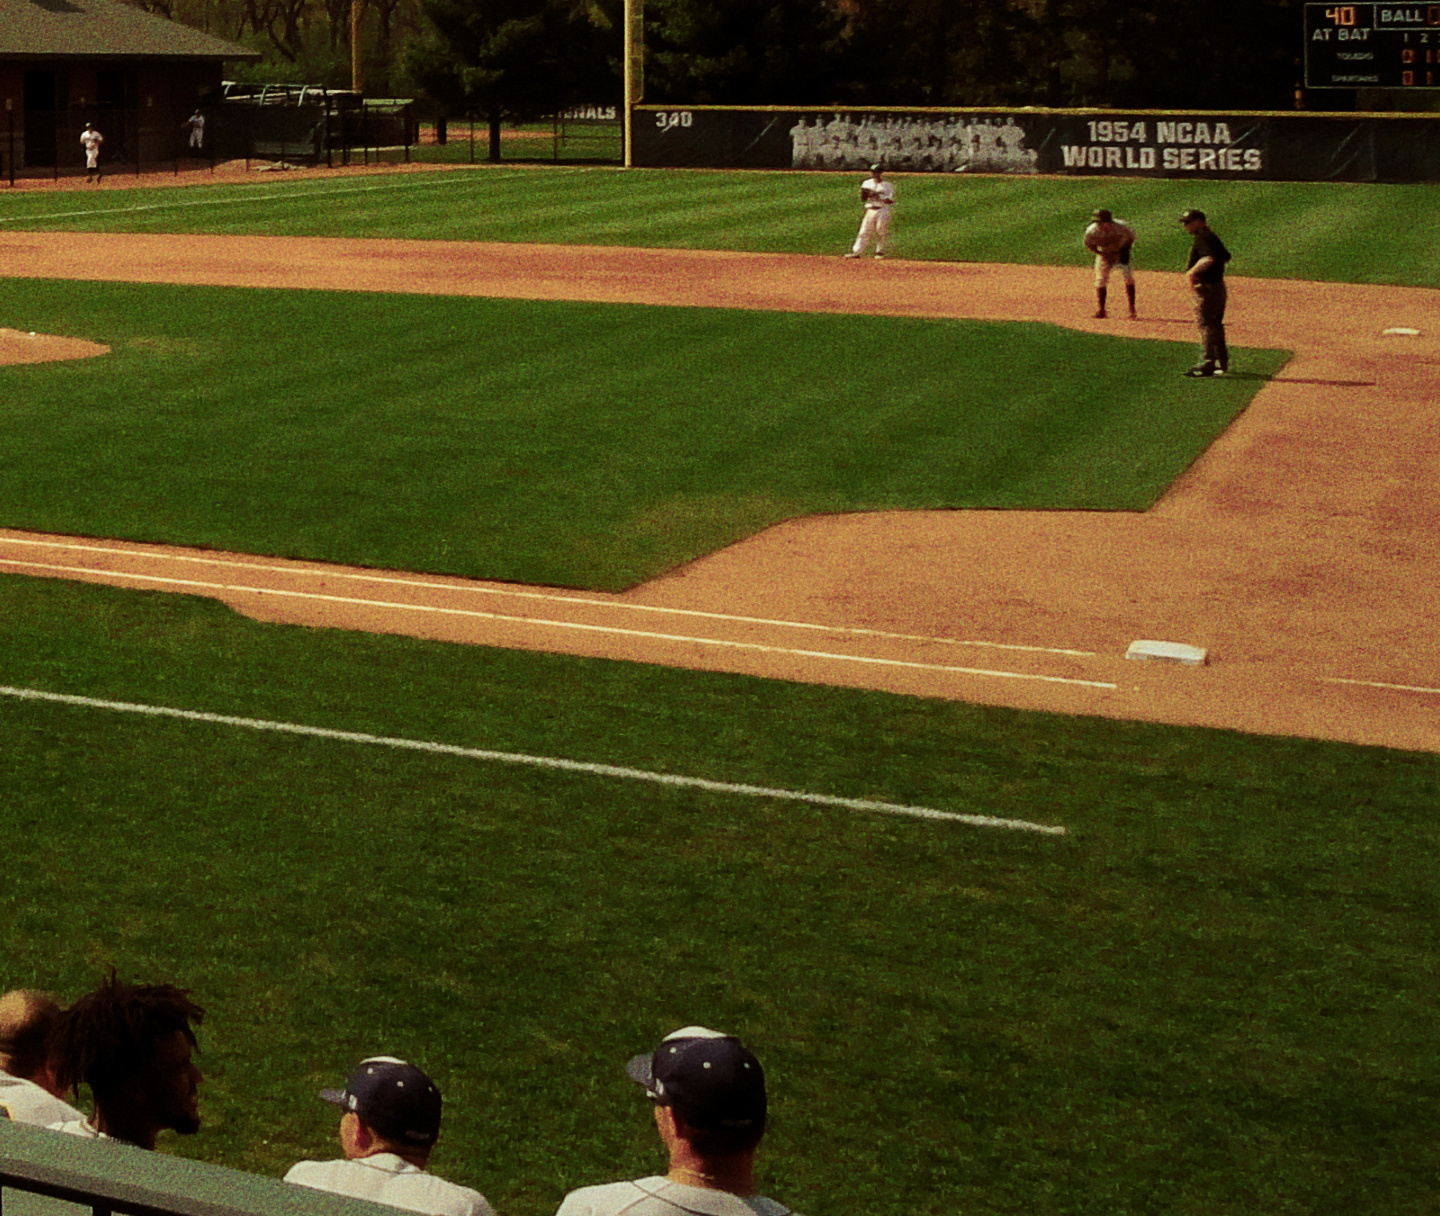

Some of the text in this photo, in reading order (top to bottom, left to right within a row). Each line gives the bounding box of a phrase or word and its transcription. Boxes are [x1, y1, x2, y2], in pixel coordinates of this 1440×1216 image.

[1325, 6, 1355, 25] 40
[1381, 9, 1424, 22] BALL
[1312, 28, 1371, 41] AT BAT
[1420, 33, 1429, 43] 2
[1087, 120, 1232, 144] 1954 NCAA
[1060, 145, 1263, 171] WORLD SERIES
